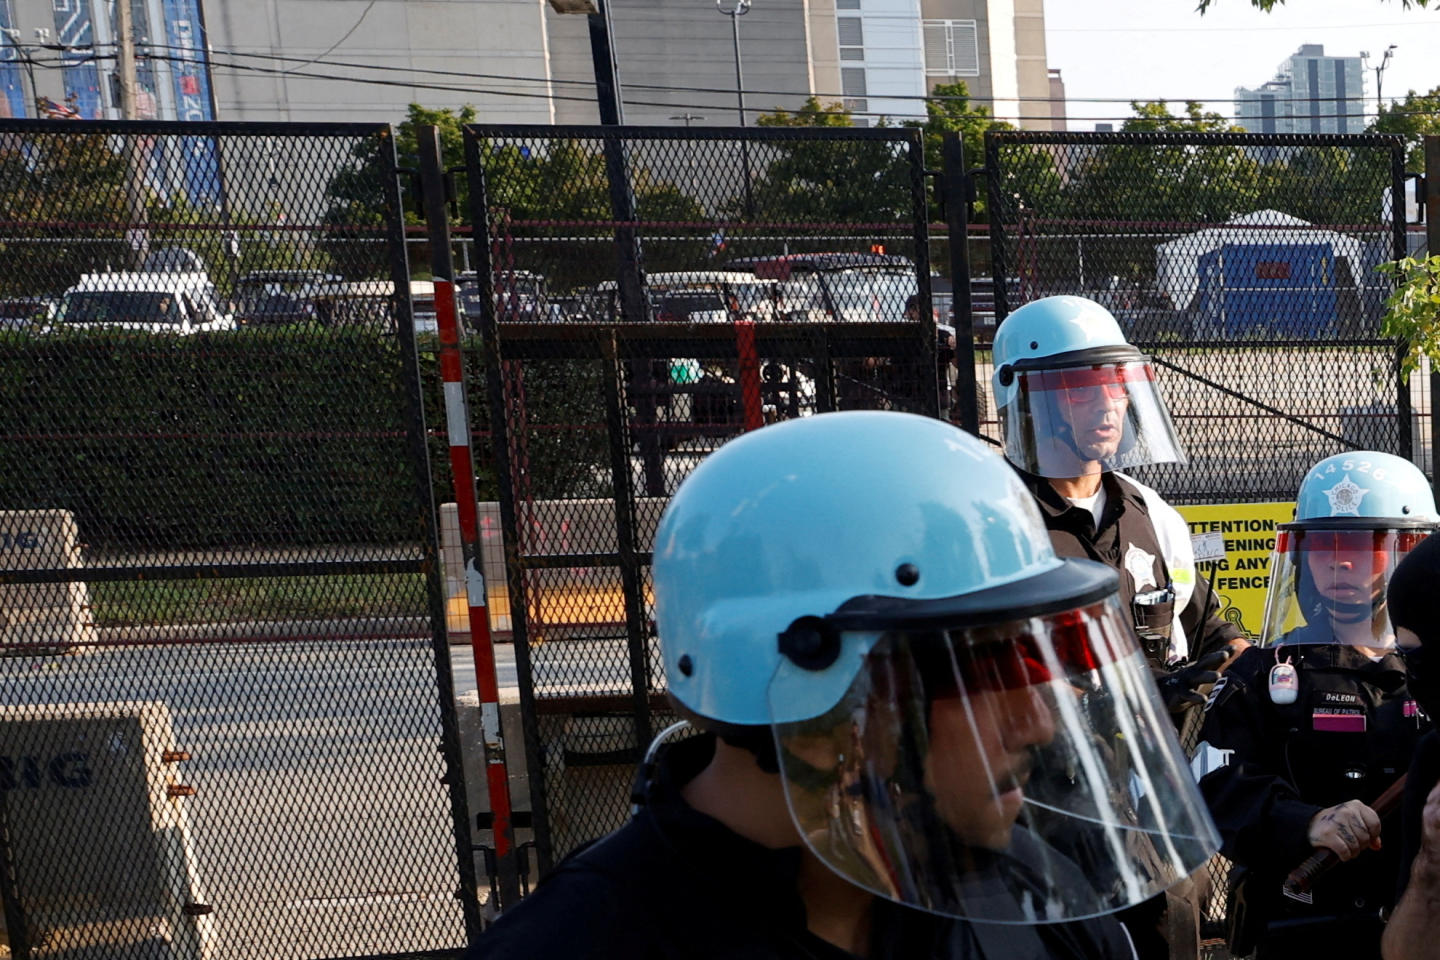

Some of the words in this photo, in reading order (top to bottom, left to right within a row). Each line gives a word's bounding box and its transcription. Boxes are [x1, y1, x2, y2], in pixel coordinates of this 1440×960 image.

[1314, 460, 1386, 481] 14526
[1187, 519, 1279, 534] TTENTION:
[1194, 557, 1229, 572] ING
[1235, 557, 1270, 571] ANY
[1325, 692, 1356, 703] DeLEON
